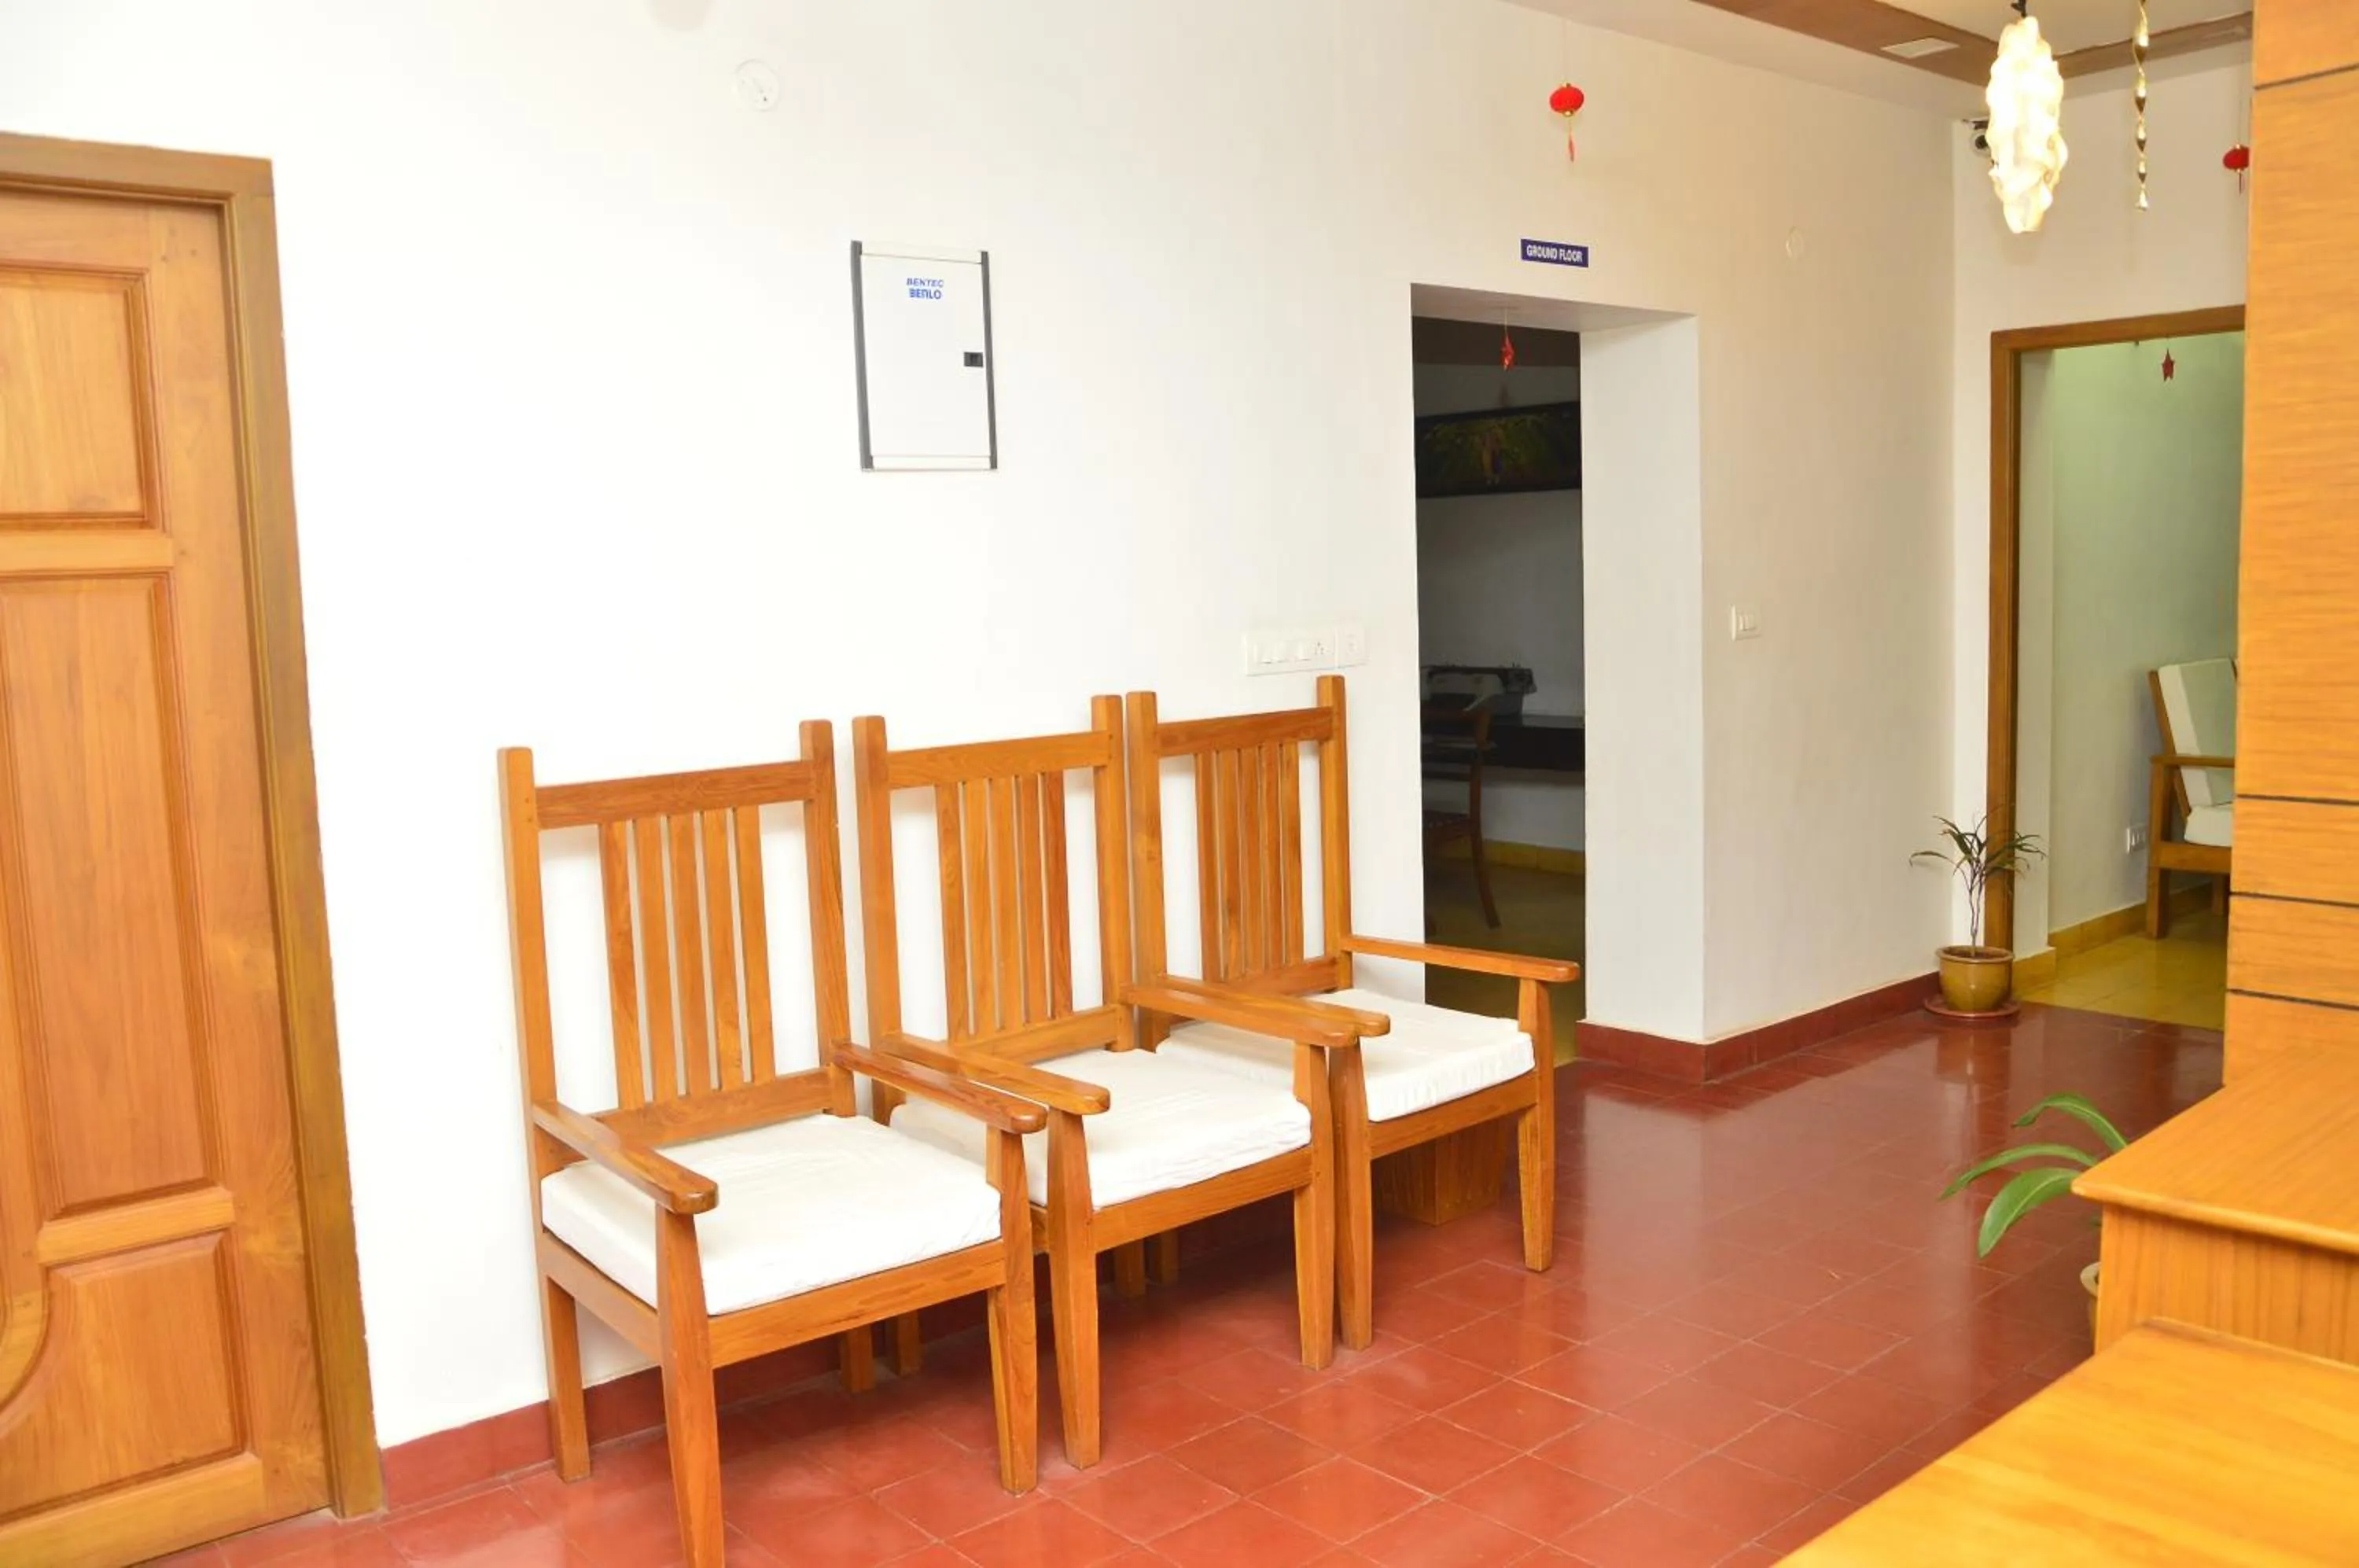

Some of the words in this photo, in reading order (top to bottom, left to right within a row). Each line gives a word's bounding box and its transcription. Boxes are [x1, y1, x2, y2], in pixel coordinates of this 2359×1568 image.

[1526, 245, 1558, 259] GROUND
[1559, 248, 1583, 263] FLOOR
[906, 278, 944, 289] BENTEC
